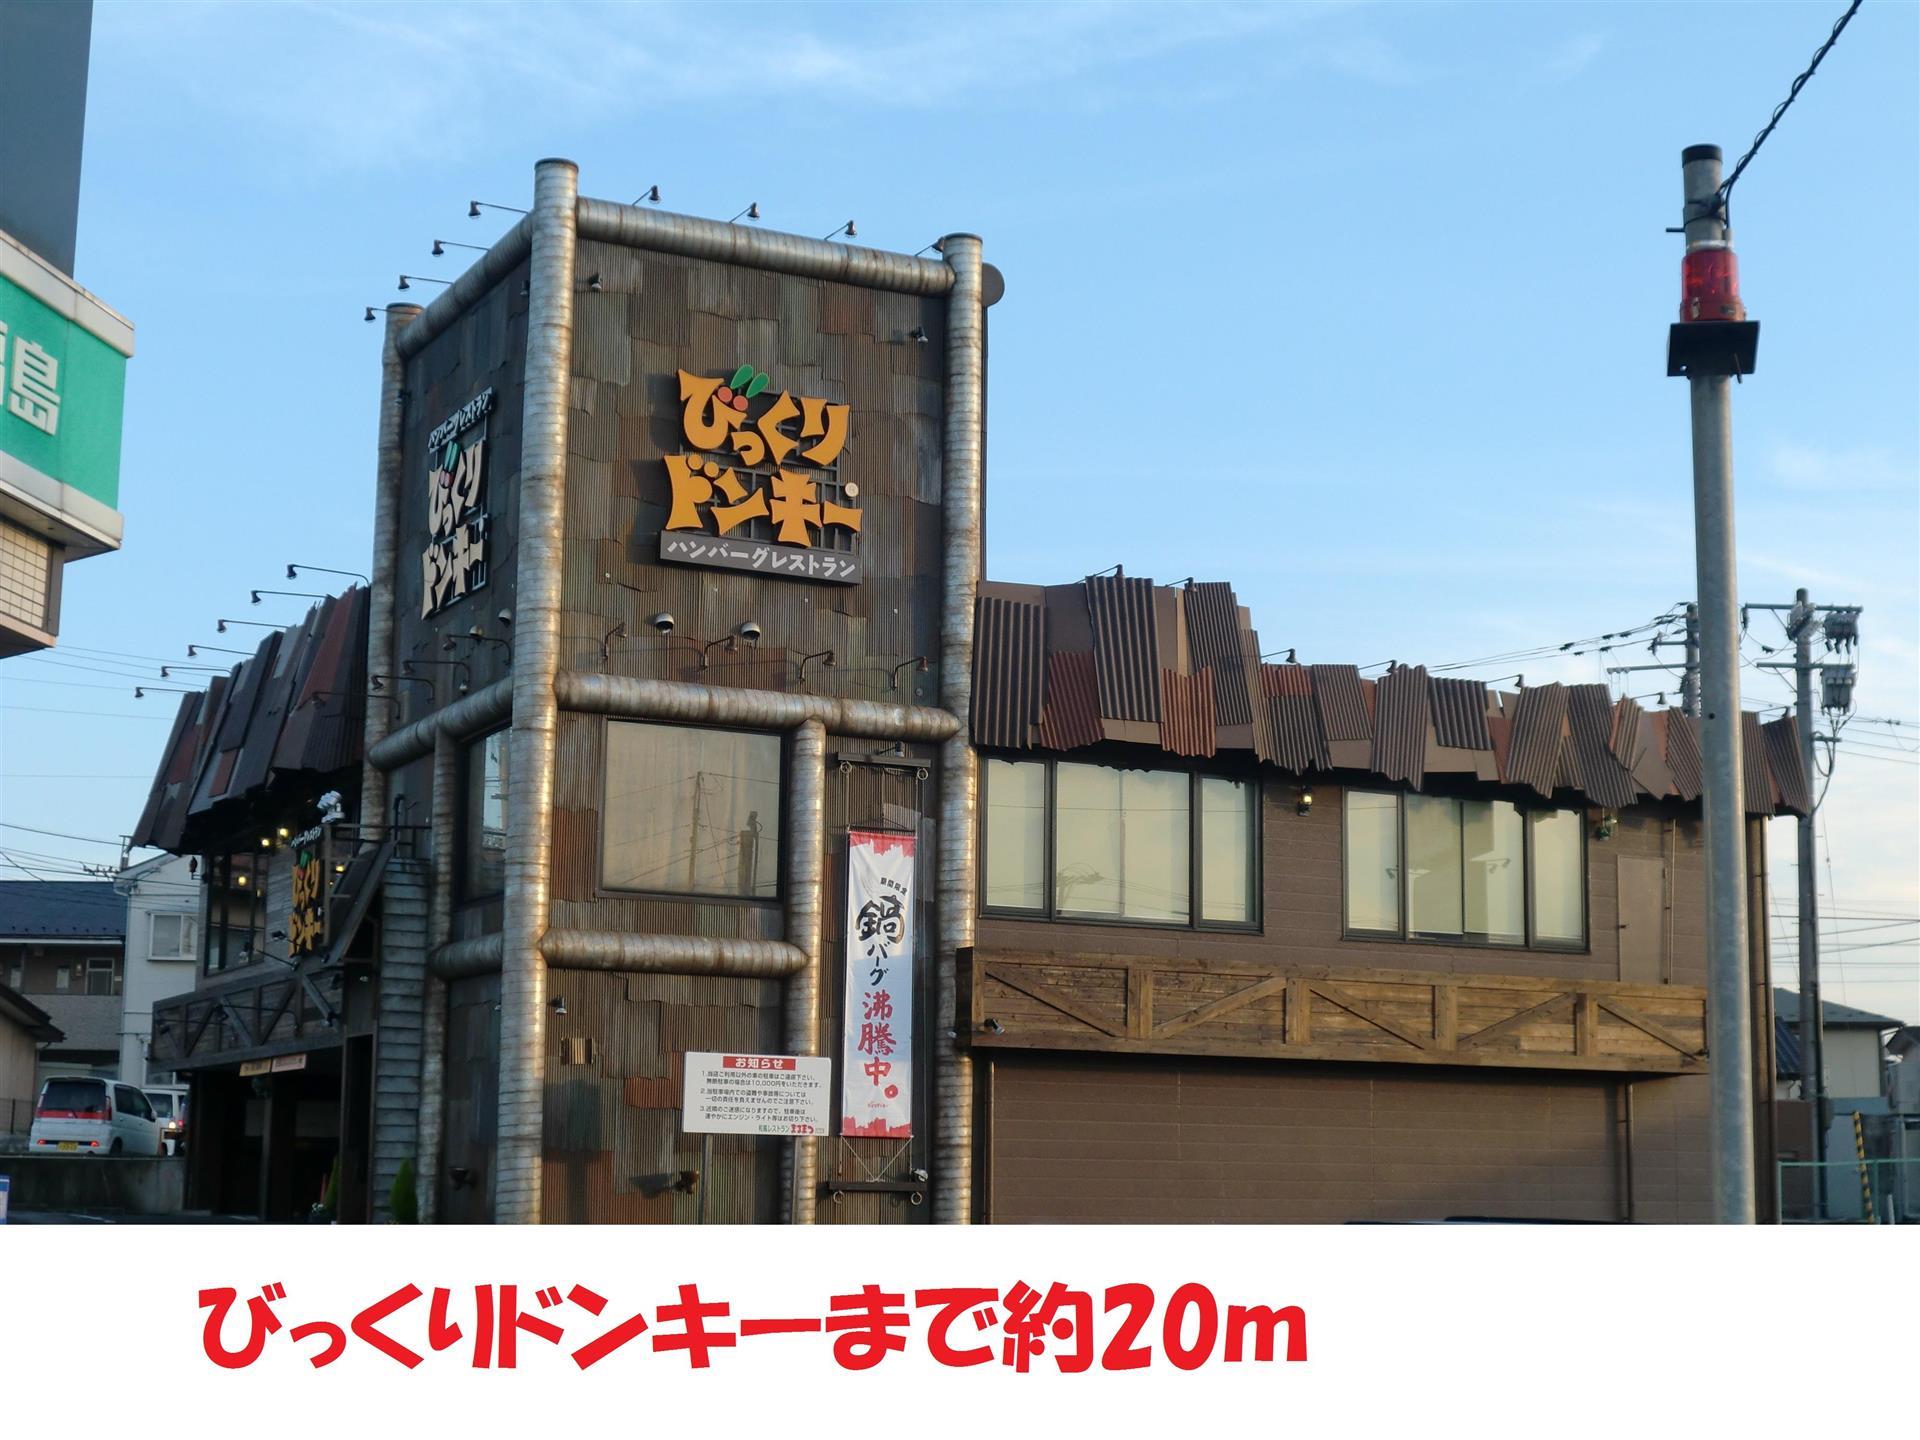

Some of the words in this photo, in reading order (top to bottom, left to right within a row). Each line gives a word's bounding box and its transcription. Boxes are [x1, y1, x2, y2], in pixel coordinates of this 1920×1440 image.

[0, 320, 60, 436] 島
[678, 368, 850, 466] びっくり
[664, 454, 863, 548] ドンキー
[421, 522, 485, 621] ドンキー
[667, 540, 856, 578] ハンバーグレストラン
[855, 894, 907, 986] 鍋バーグ
[735, 1057, 784, 1070] お知らせ
[857, 991, 899, 1099] 沸騰中。
